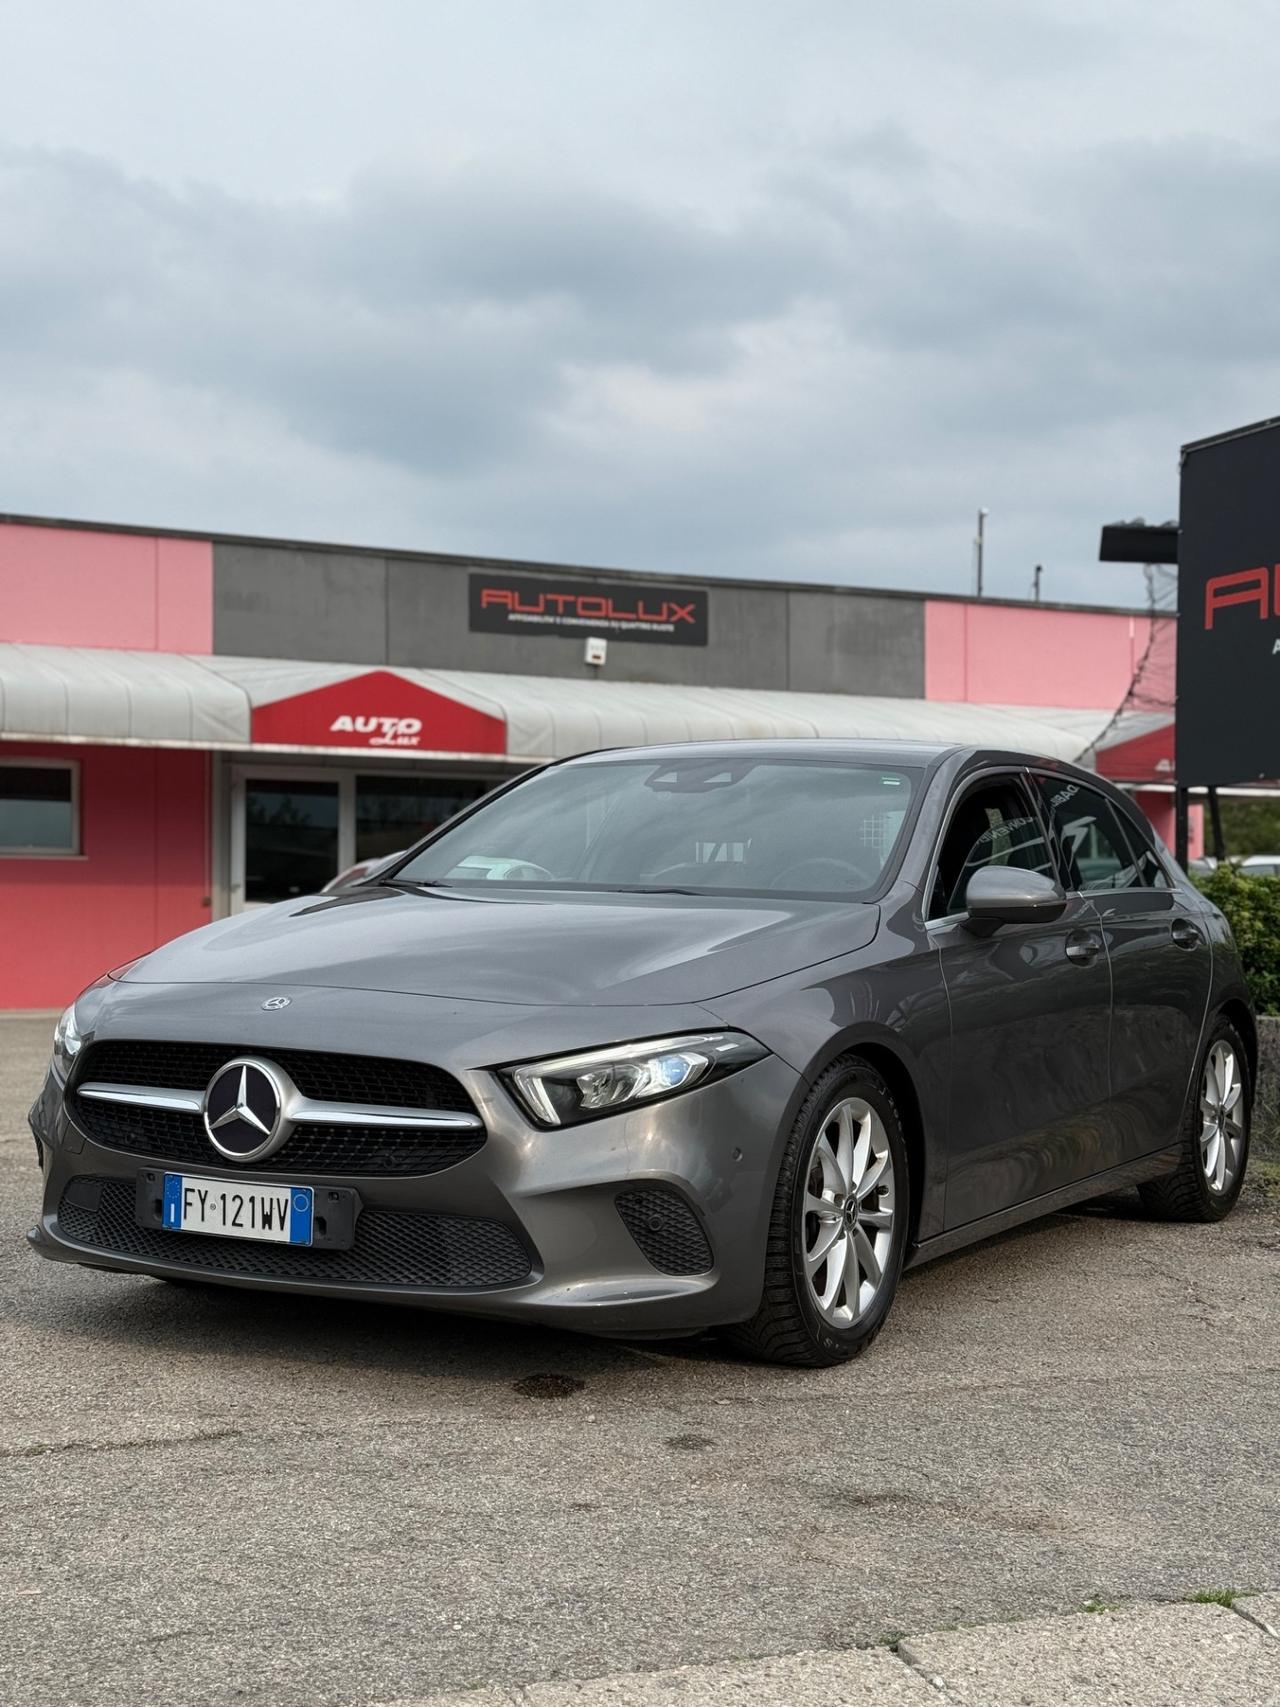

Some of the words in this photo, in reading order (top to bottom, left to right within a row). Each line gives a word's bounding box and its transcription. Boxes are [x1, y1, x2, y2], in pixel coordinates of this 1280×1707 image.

[481, 588, 696, 623] AUTOLUX
[329, 715, 423, 735] AUTO
[184, 1188, 208, 1222] FY
[220, 1193, 289, 1231] 121WV
